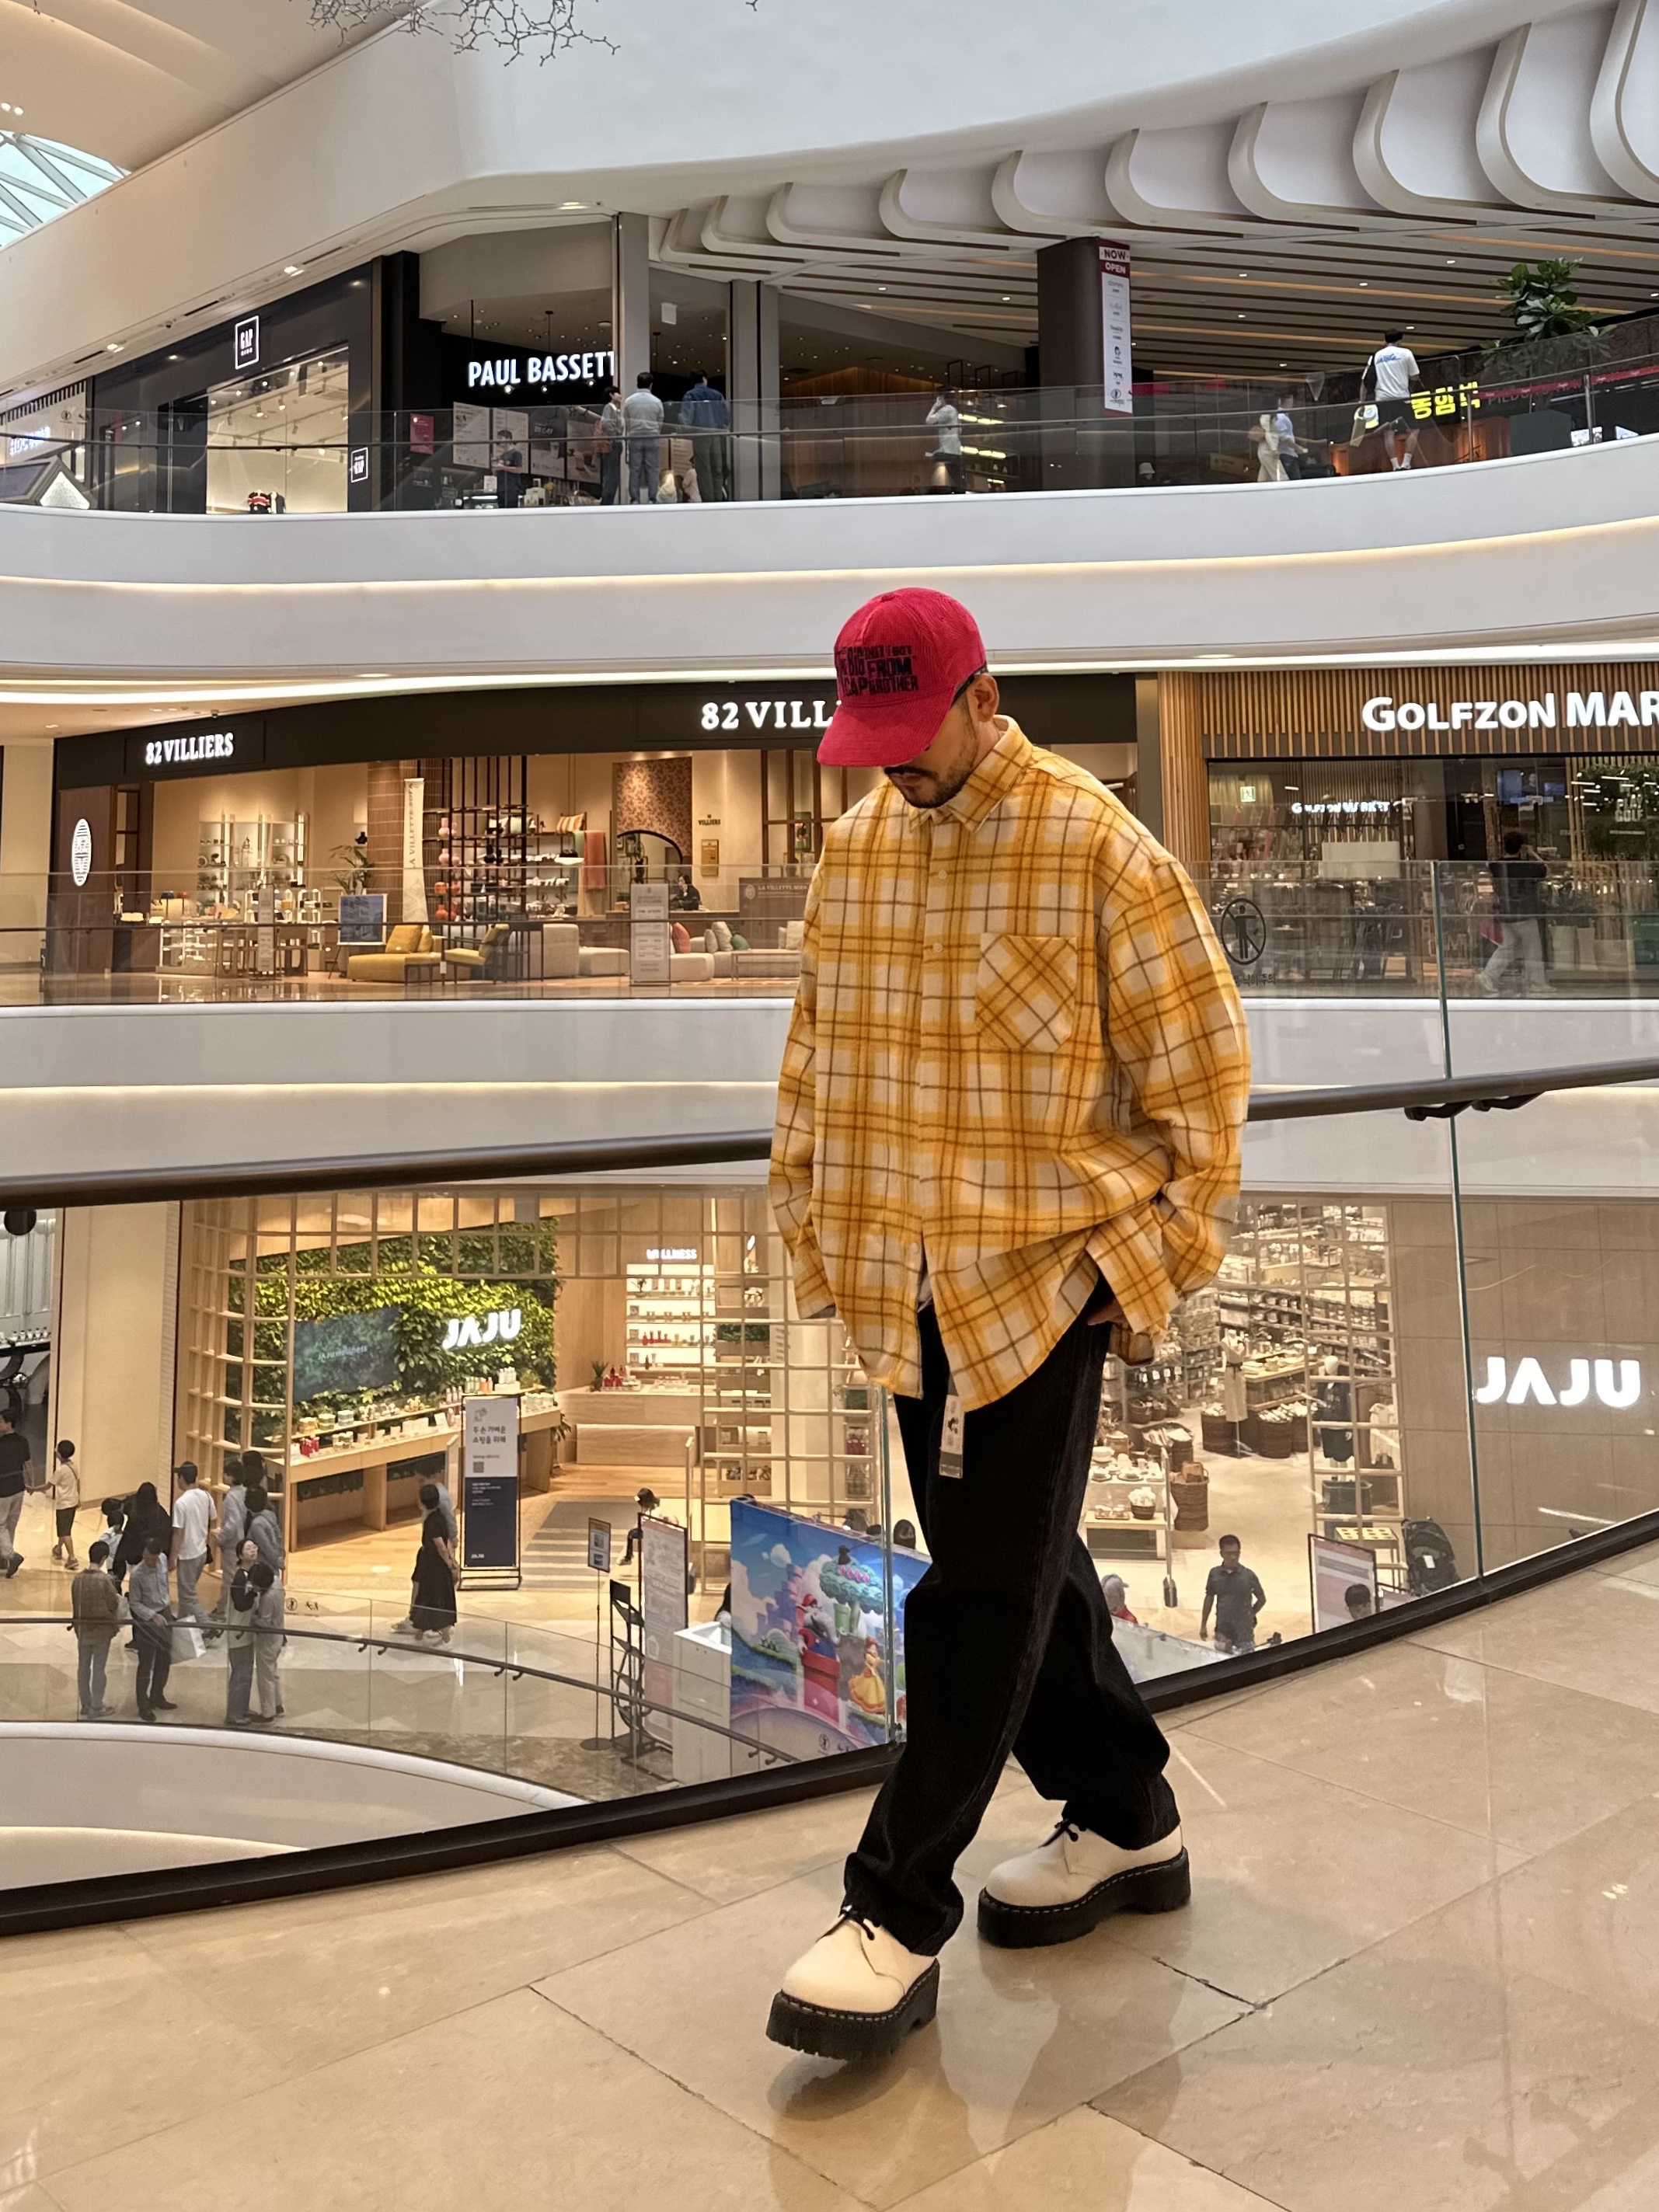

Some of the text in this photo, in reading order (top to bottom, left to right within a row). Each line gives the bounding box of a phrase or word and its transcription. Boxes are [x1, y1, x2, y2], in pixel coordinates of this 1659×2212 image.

[1104, 249, 1126, 260] NOW
[1105, 262, 1126, 274] OPEN
[240, 329, 253, 350] GAP
[468, 351, 615, 388] PAUL BASSETT
[867, 657, 913, 678] FROM
[1362, 691, 1659, 730] GOLFZON MAR
[1615, 810, 1643, 822] GOLF
[441, 1308, 523, 1350] JAJU
[1475, 1355, 1641, 1408] JAJU
